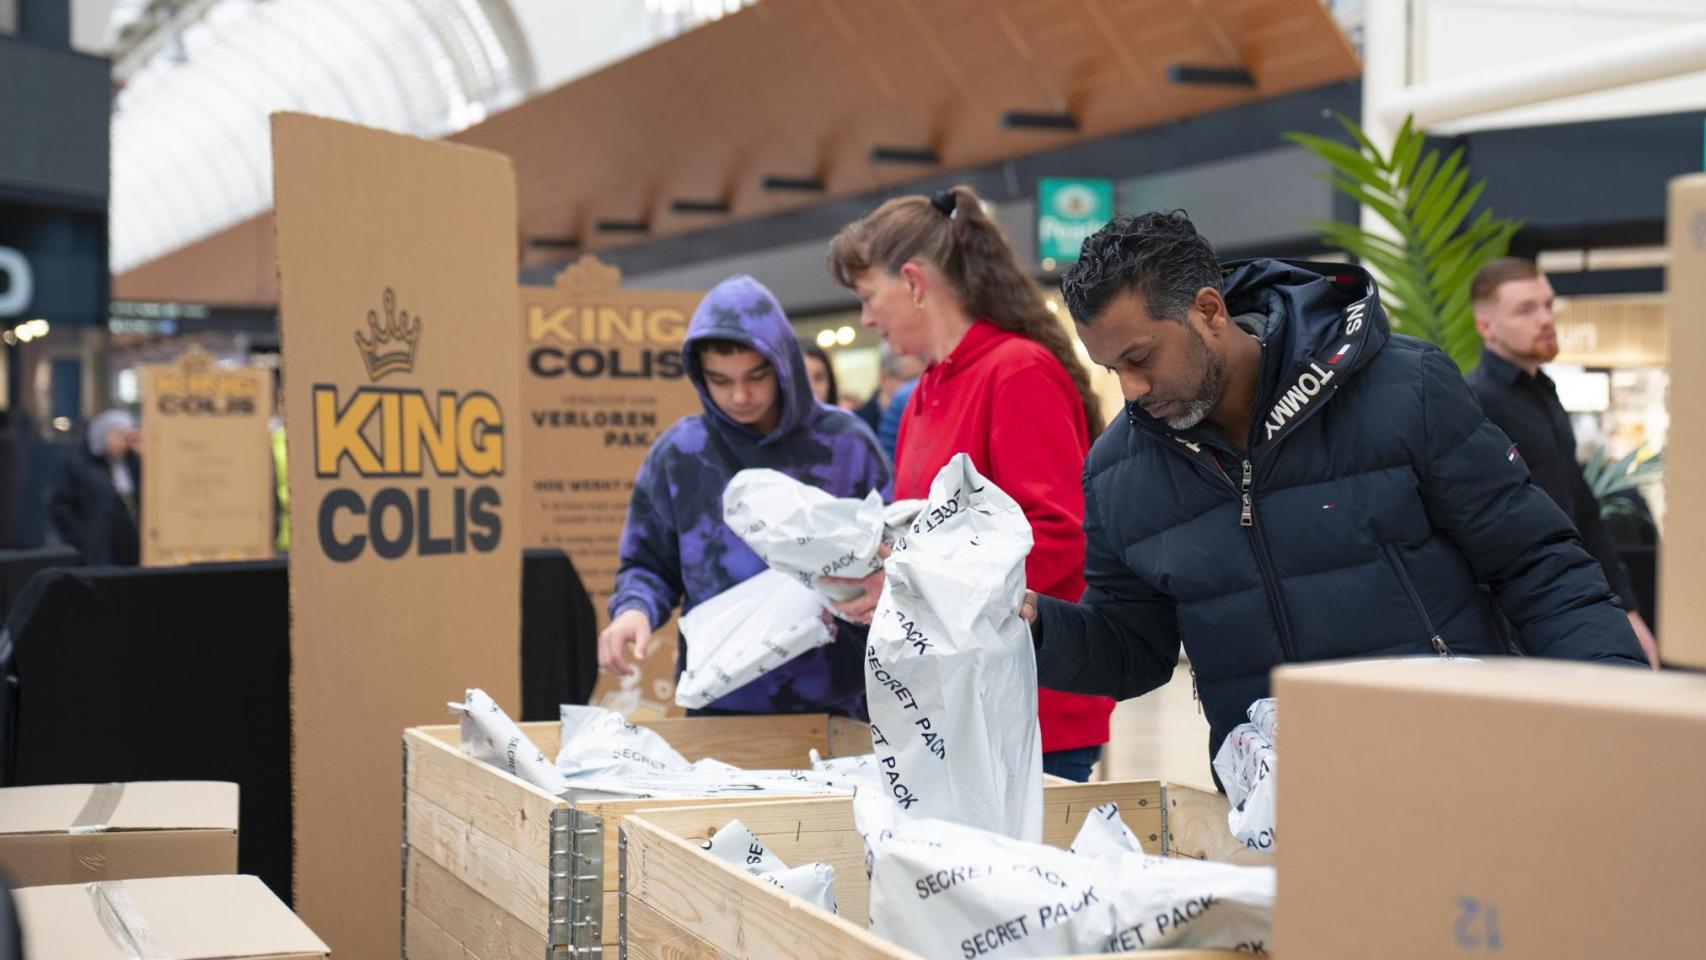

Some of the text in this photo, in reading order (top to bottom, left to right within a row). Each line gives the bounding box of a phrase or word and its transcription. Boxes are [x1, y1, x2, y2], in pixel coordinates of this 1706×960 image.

[526, 303, 690, 345] KING
[529, 347, 686, 380] COLIS
[531, 411, 657, 428] VERLOREN
[1264, 362, 1335, 441] TOMMY
[312, 384, 504, 478] KING
[317, 485, 502, 563] COLIS
[822, 551, 860, 577] PACK
[868, 646, 918, 710] SECRET
[882, 756, 919, 810] PACK
[1155, 893, 1217, 935] PACK
[961, 915, 1029, 960] SECRET
